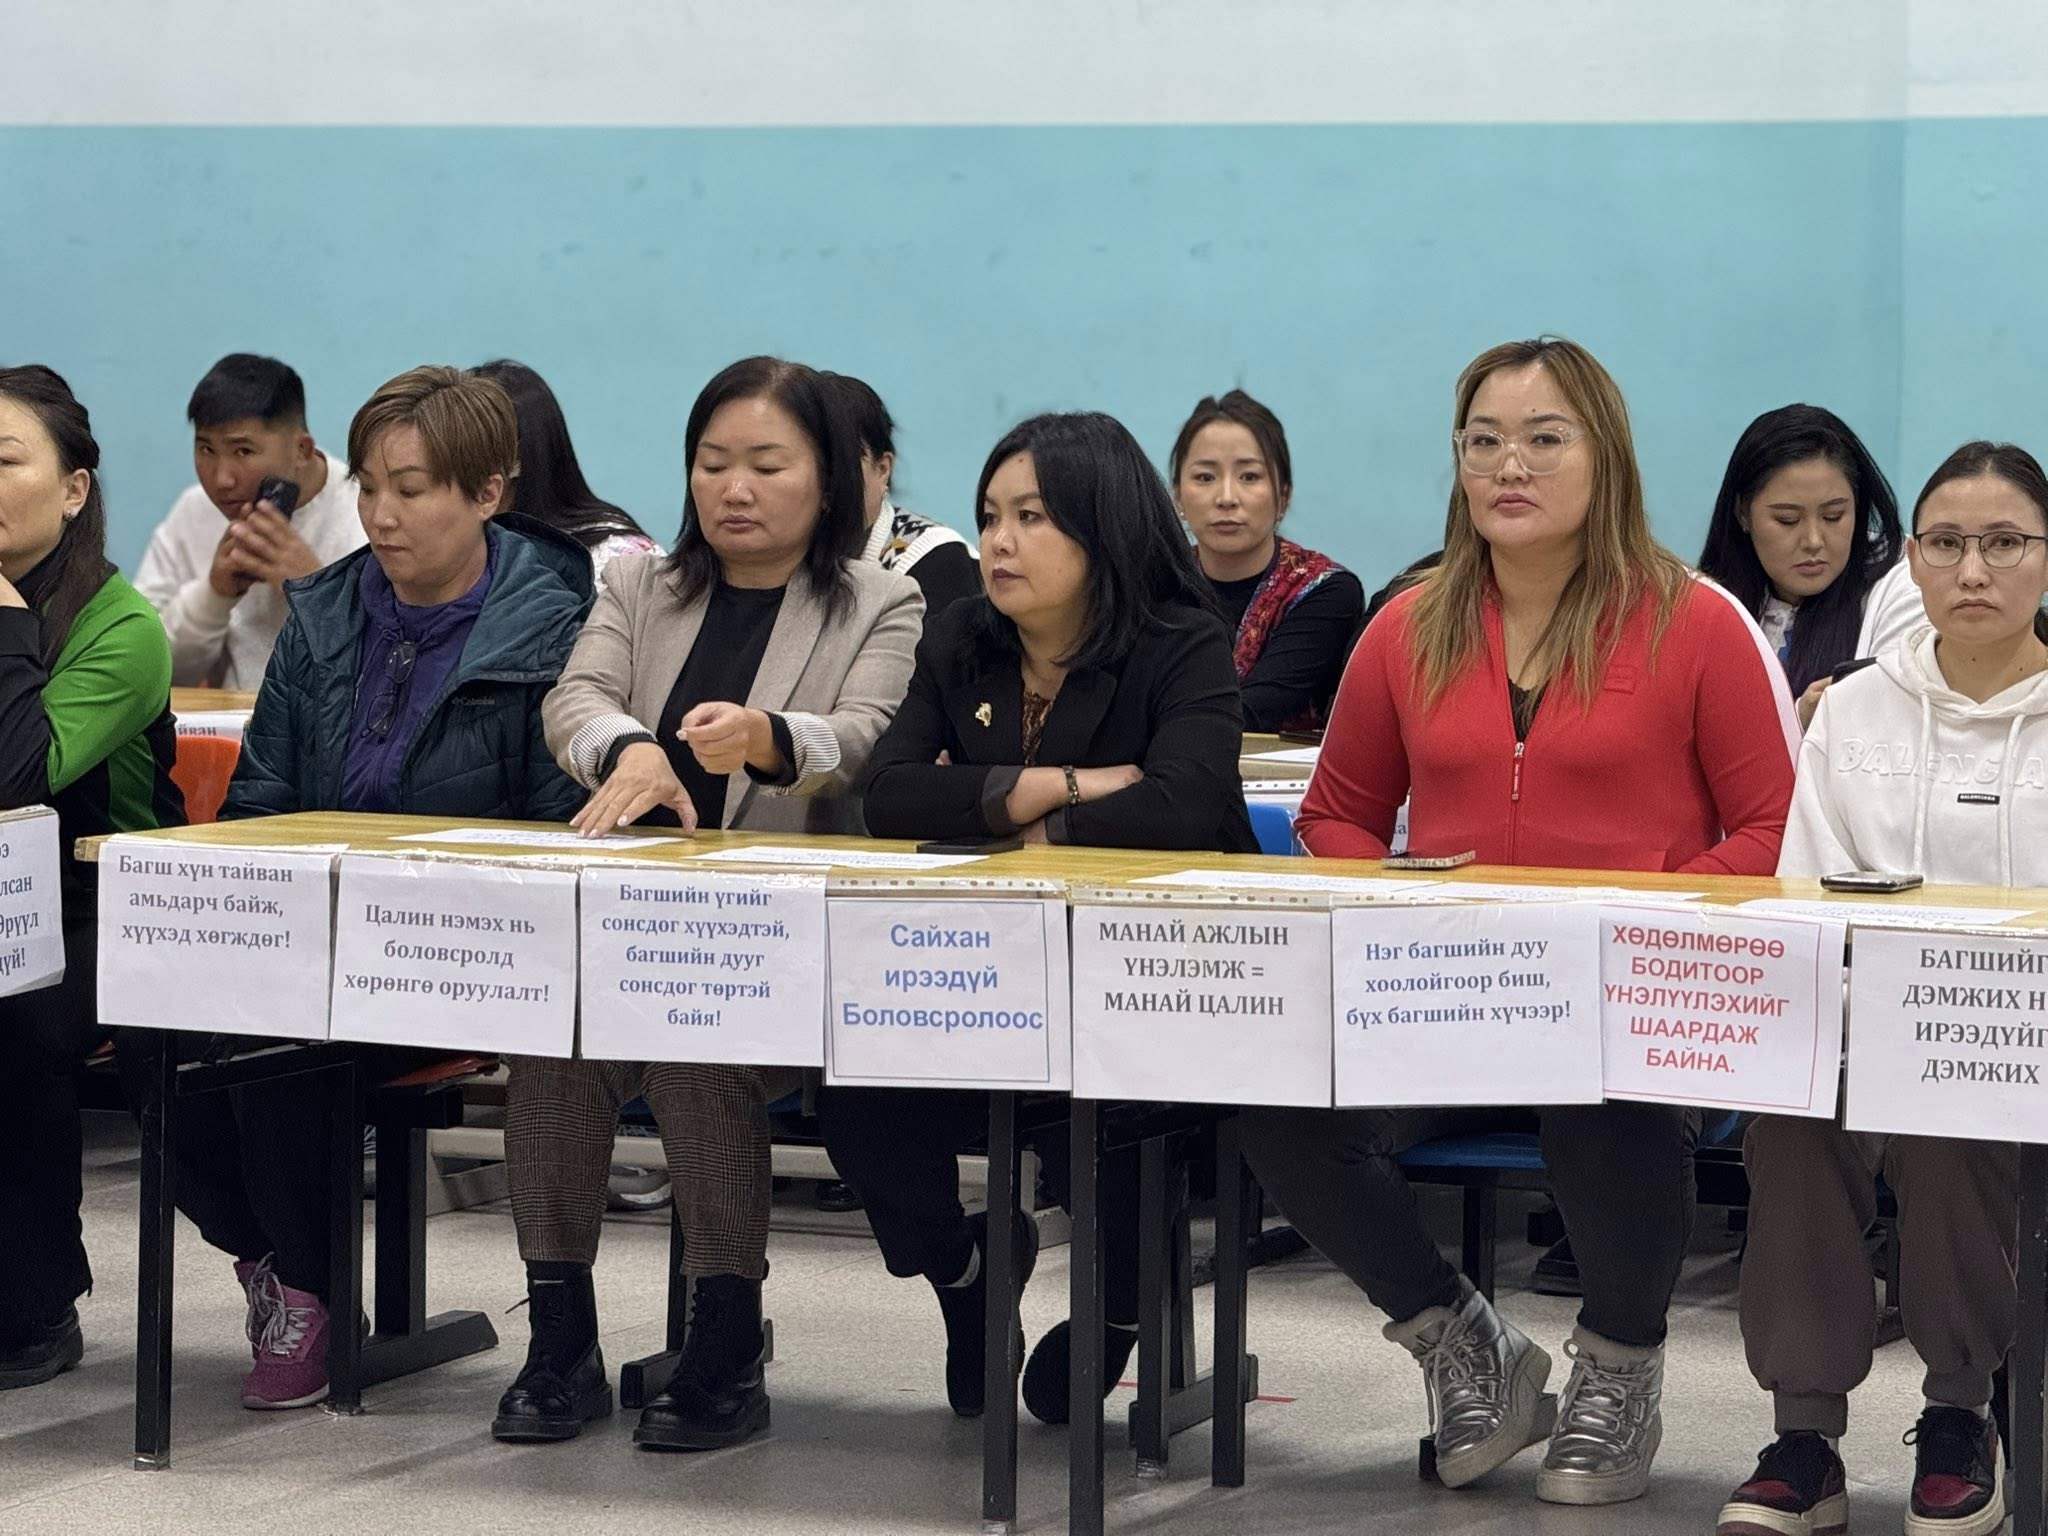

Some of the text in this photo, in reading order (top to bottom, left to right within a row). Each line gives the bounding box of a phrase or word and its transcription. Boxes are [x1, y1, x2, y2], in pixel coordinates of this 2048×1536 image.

[120, 856, 292, 882] Багш хүн тайван
[130, 893, 283, 917] амьдарч байж,
[620, 885, 771, 909] Багшийн үгийг
[366, 905, 535, 933] Цалин нэмэх нь
[602, 918, 789, 940] сонсдог хүүхэдтэй,
[122, 925, 289, 950] хүүхэд хөгждөг!
[891, 924, 989, 948] Сайхан
[1100, 920, 1288, 945] МАНАЙ АЖЛЫН
[1613, 925, 1784, 958] ХӨДӨЛМӨРӨӨ
[384, 940, 513, 969] боловсролд
[626, 945, 764, 971] багшийн дууг
[1367, 939, 1548, 960] Нэг багшийн дуу
[886, 966, 997, 993] ирээдүй
[1124, 958, 1264, 979] ҮНЭЛЭМЖ =
[1366, 970, 1550, 993] хоолойгоор биш,
[1632, 957, 1763, 985] БОДИТООР
[345, 975, 548, 1002] хөрөнгө оруулалт!
[620, 980, 770, 1001] сонсдог төртэй
[1604, 984, 1789, 1016] ҮНЭЛҮҮЛЭХИЙГ
[1903, 985, 2021, 1009] ДЭМЖИХ
[1105, 989, 1283, 1017] МАНАЙ ЦАЛИН
[1347, 1001, 1570, 1029] бүх багшийн хүчээр!
[668, 1008, 720, 1026] байя!
[843, 1003, 1042, 1033] Боловсролоос
[1631, 1016, 1759, 1045] ШААРДАЖ
[1647, 1047, 1734, 1073] БАЙНА.
[1921, 1059, 2040, 1084] ДЭМЖИХ
